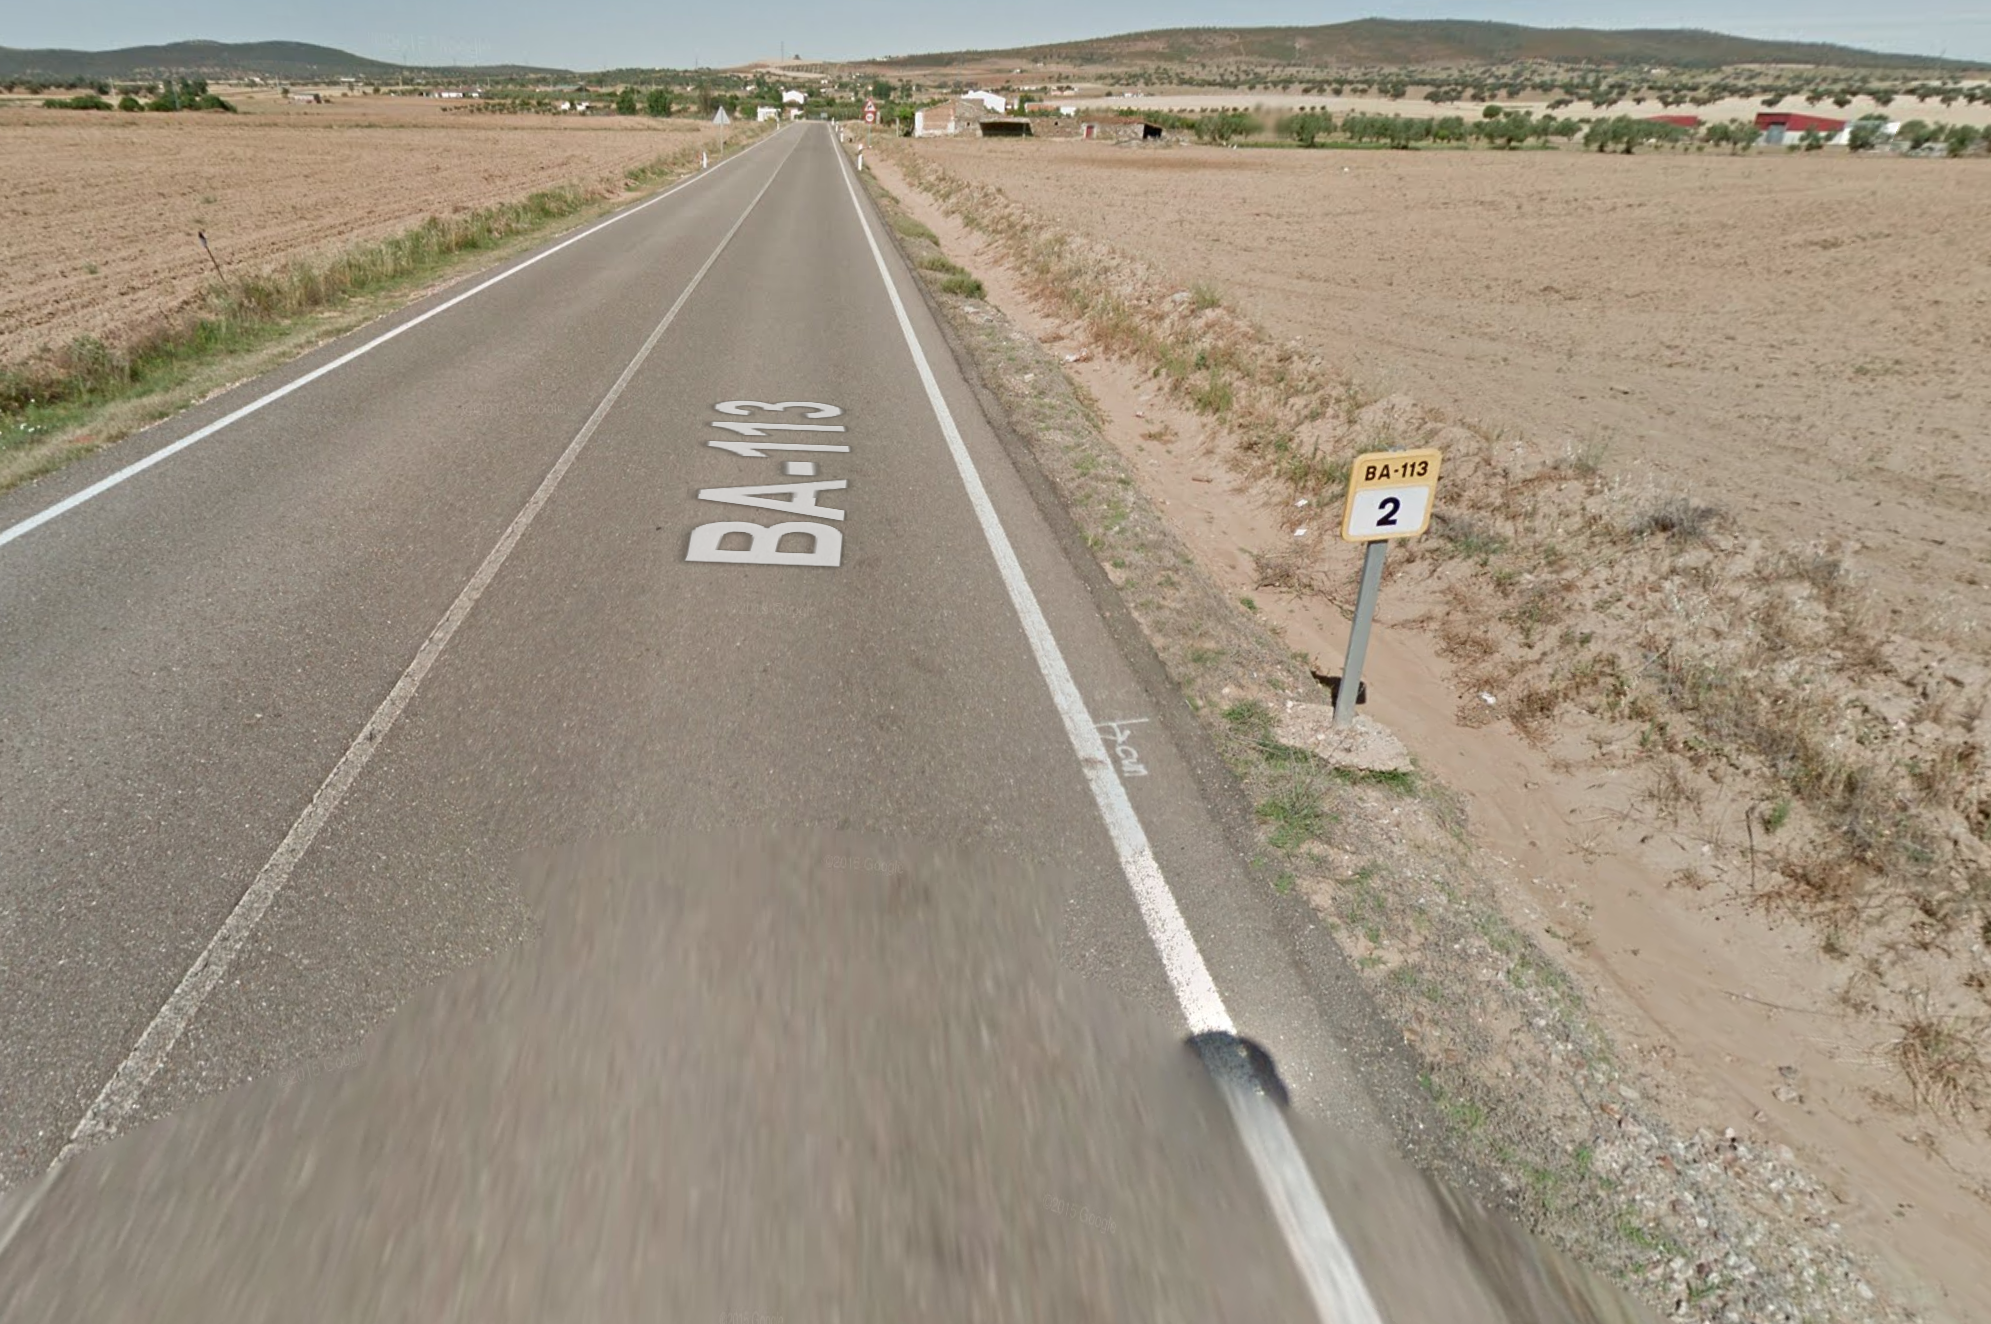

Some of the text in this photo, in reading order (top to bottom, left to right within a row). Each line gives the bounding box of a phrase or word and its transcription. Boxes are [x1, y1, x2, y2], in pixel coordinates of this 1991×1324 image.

[685, 400, 850, 567] BA-113
[1364, 460, 1429, 481] BA-113
[1375, 496, 1401, 527] 2
